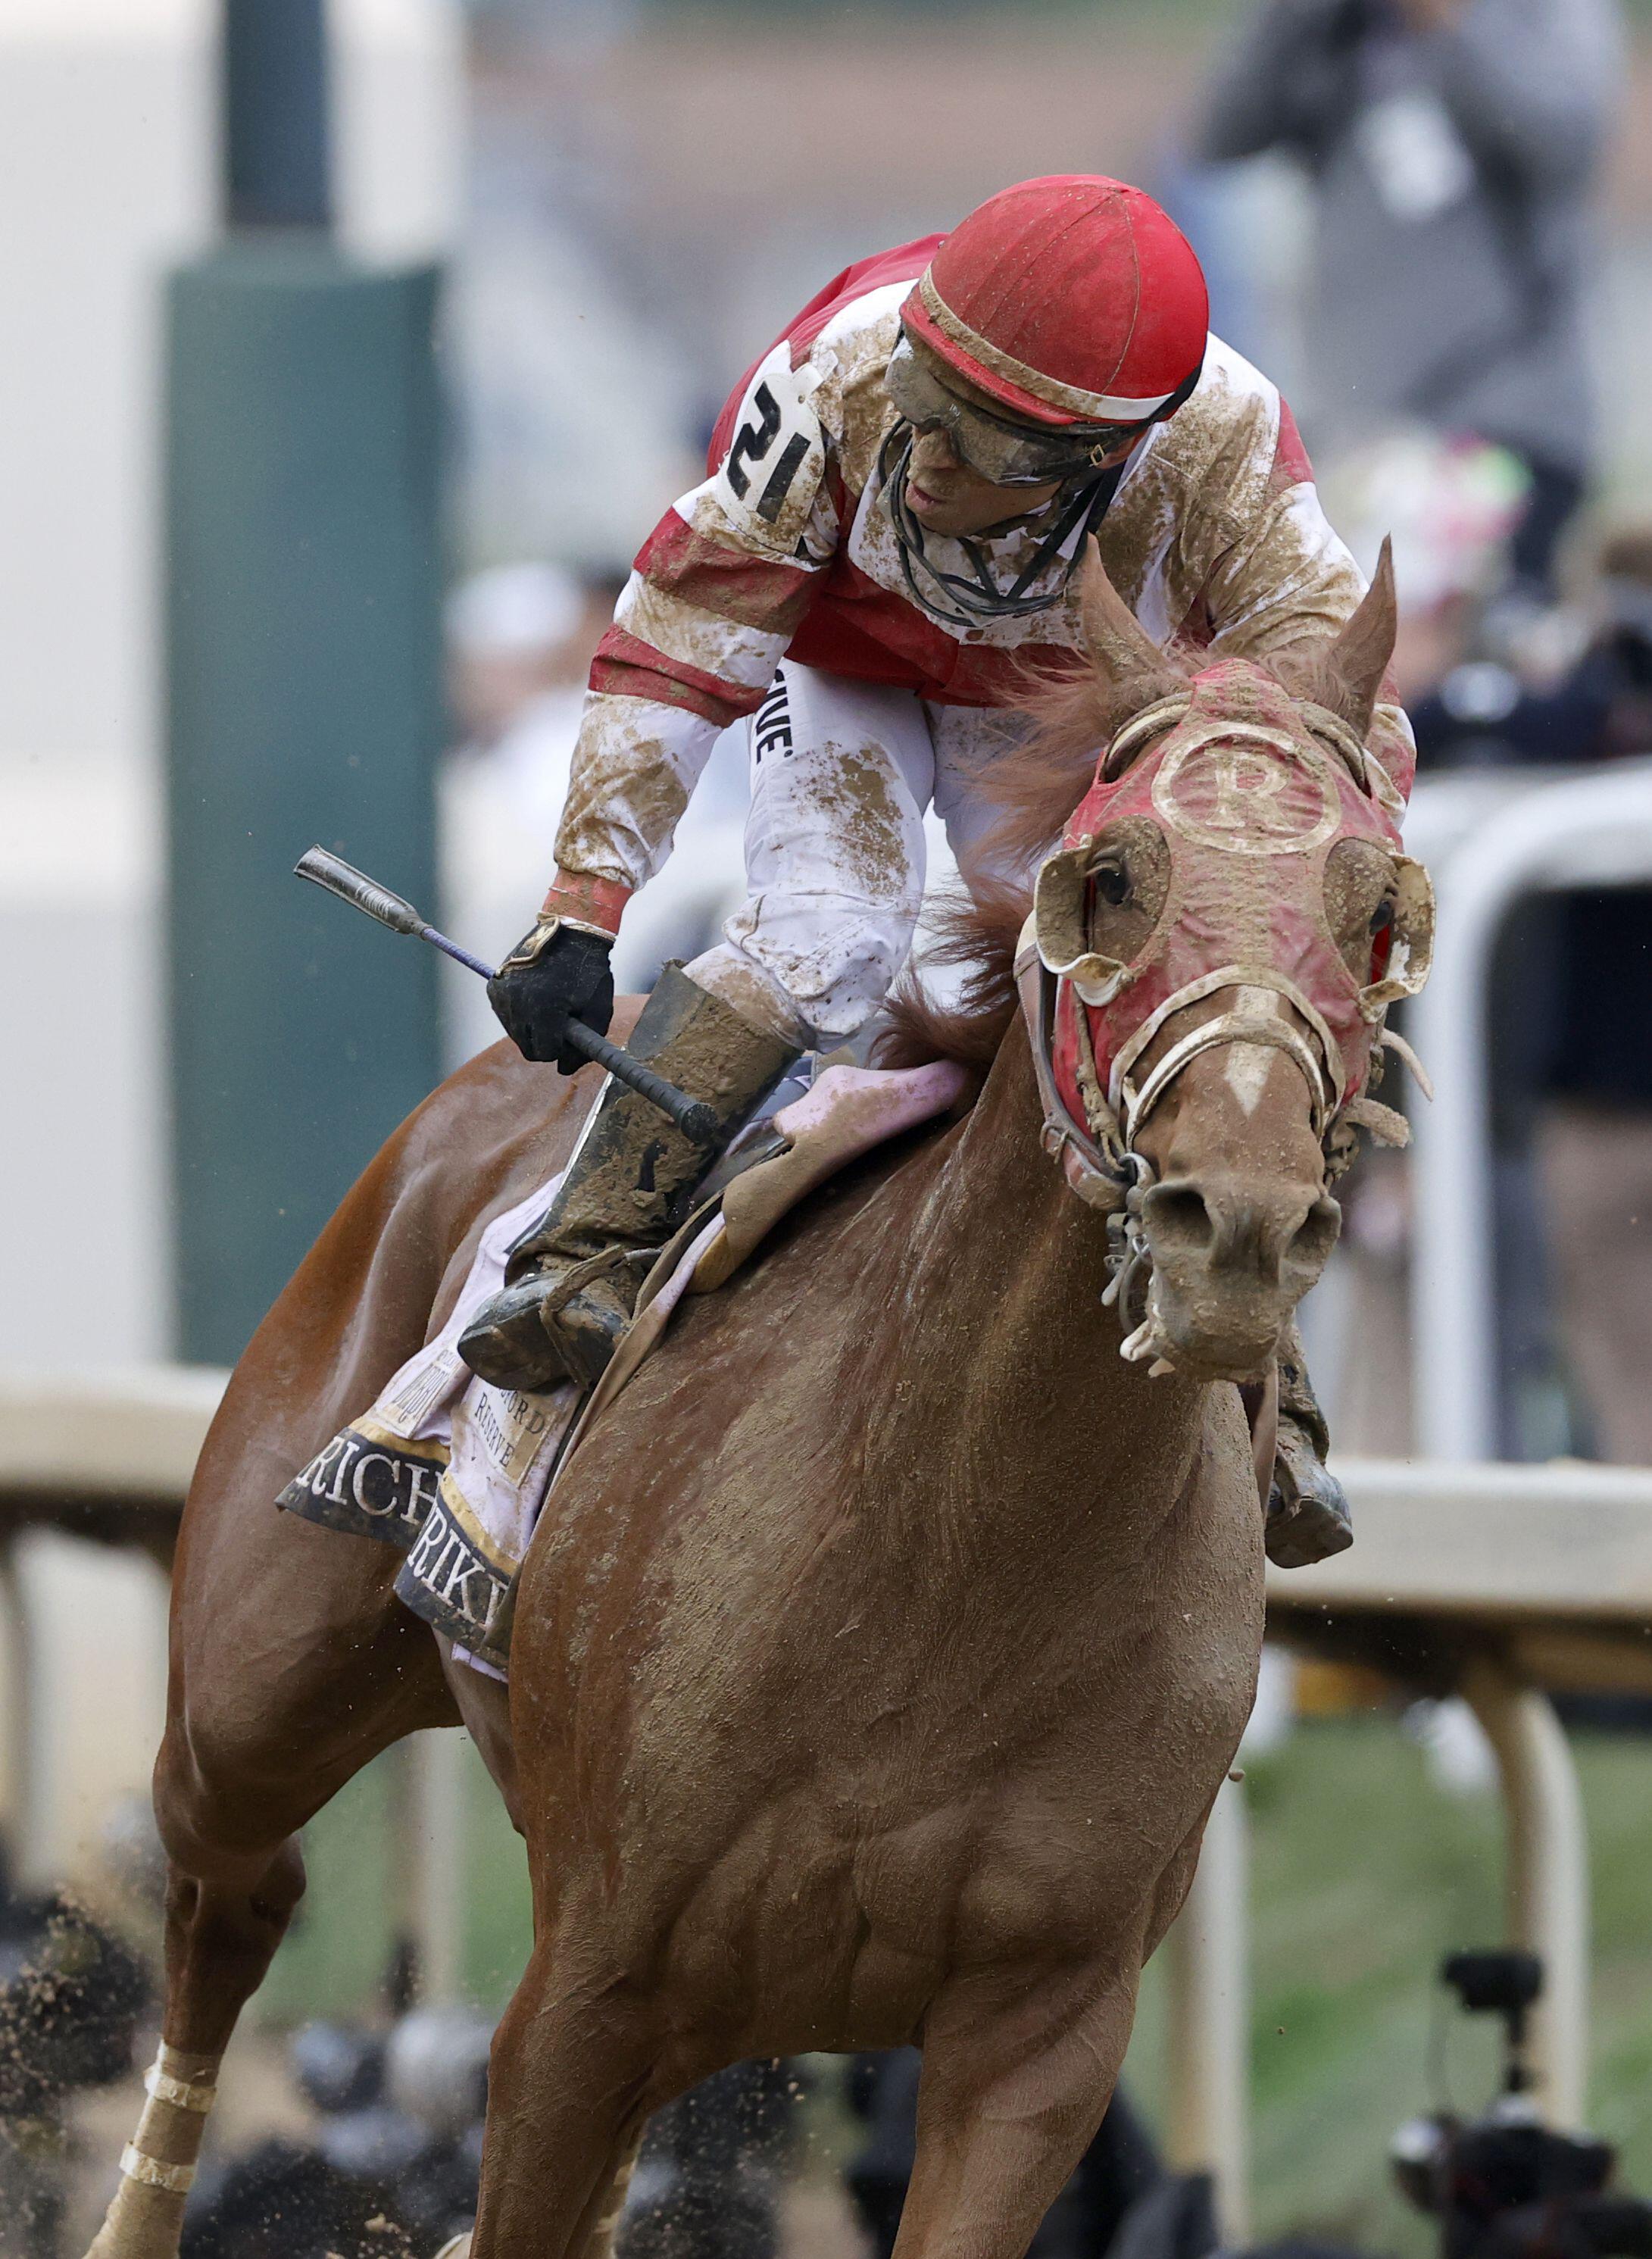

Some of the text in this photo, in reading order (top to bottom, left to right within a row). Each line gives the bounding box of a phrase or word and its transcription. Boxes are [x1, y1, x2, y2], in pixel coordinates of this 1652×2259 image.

[726, 380, 811, 523] 21
[756, 668, 793, 765] IVE
[1204, 747, 1295, 832] R
[475, 1392, 515, 1467] RESERVE
[295, 1436, 445, 1526] RICH
